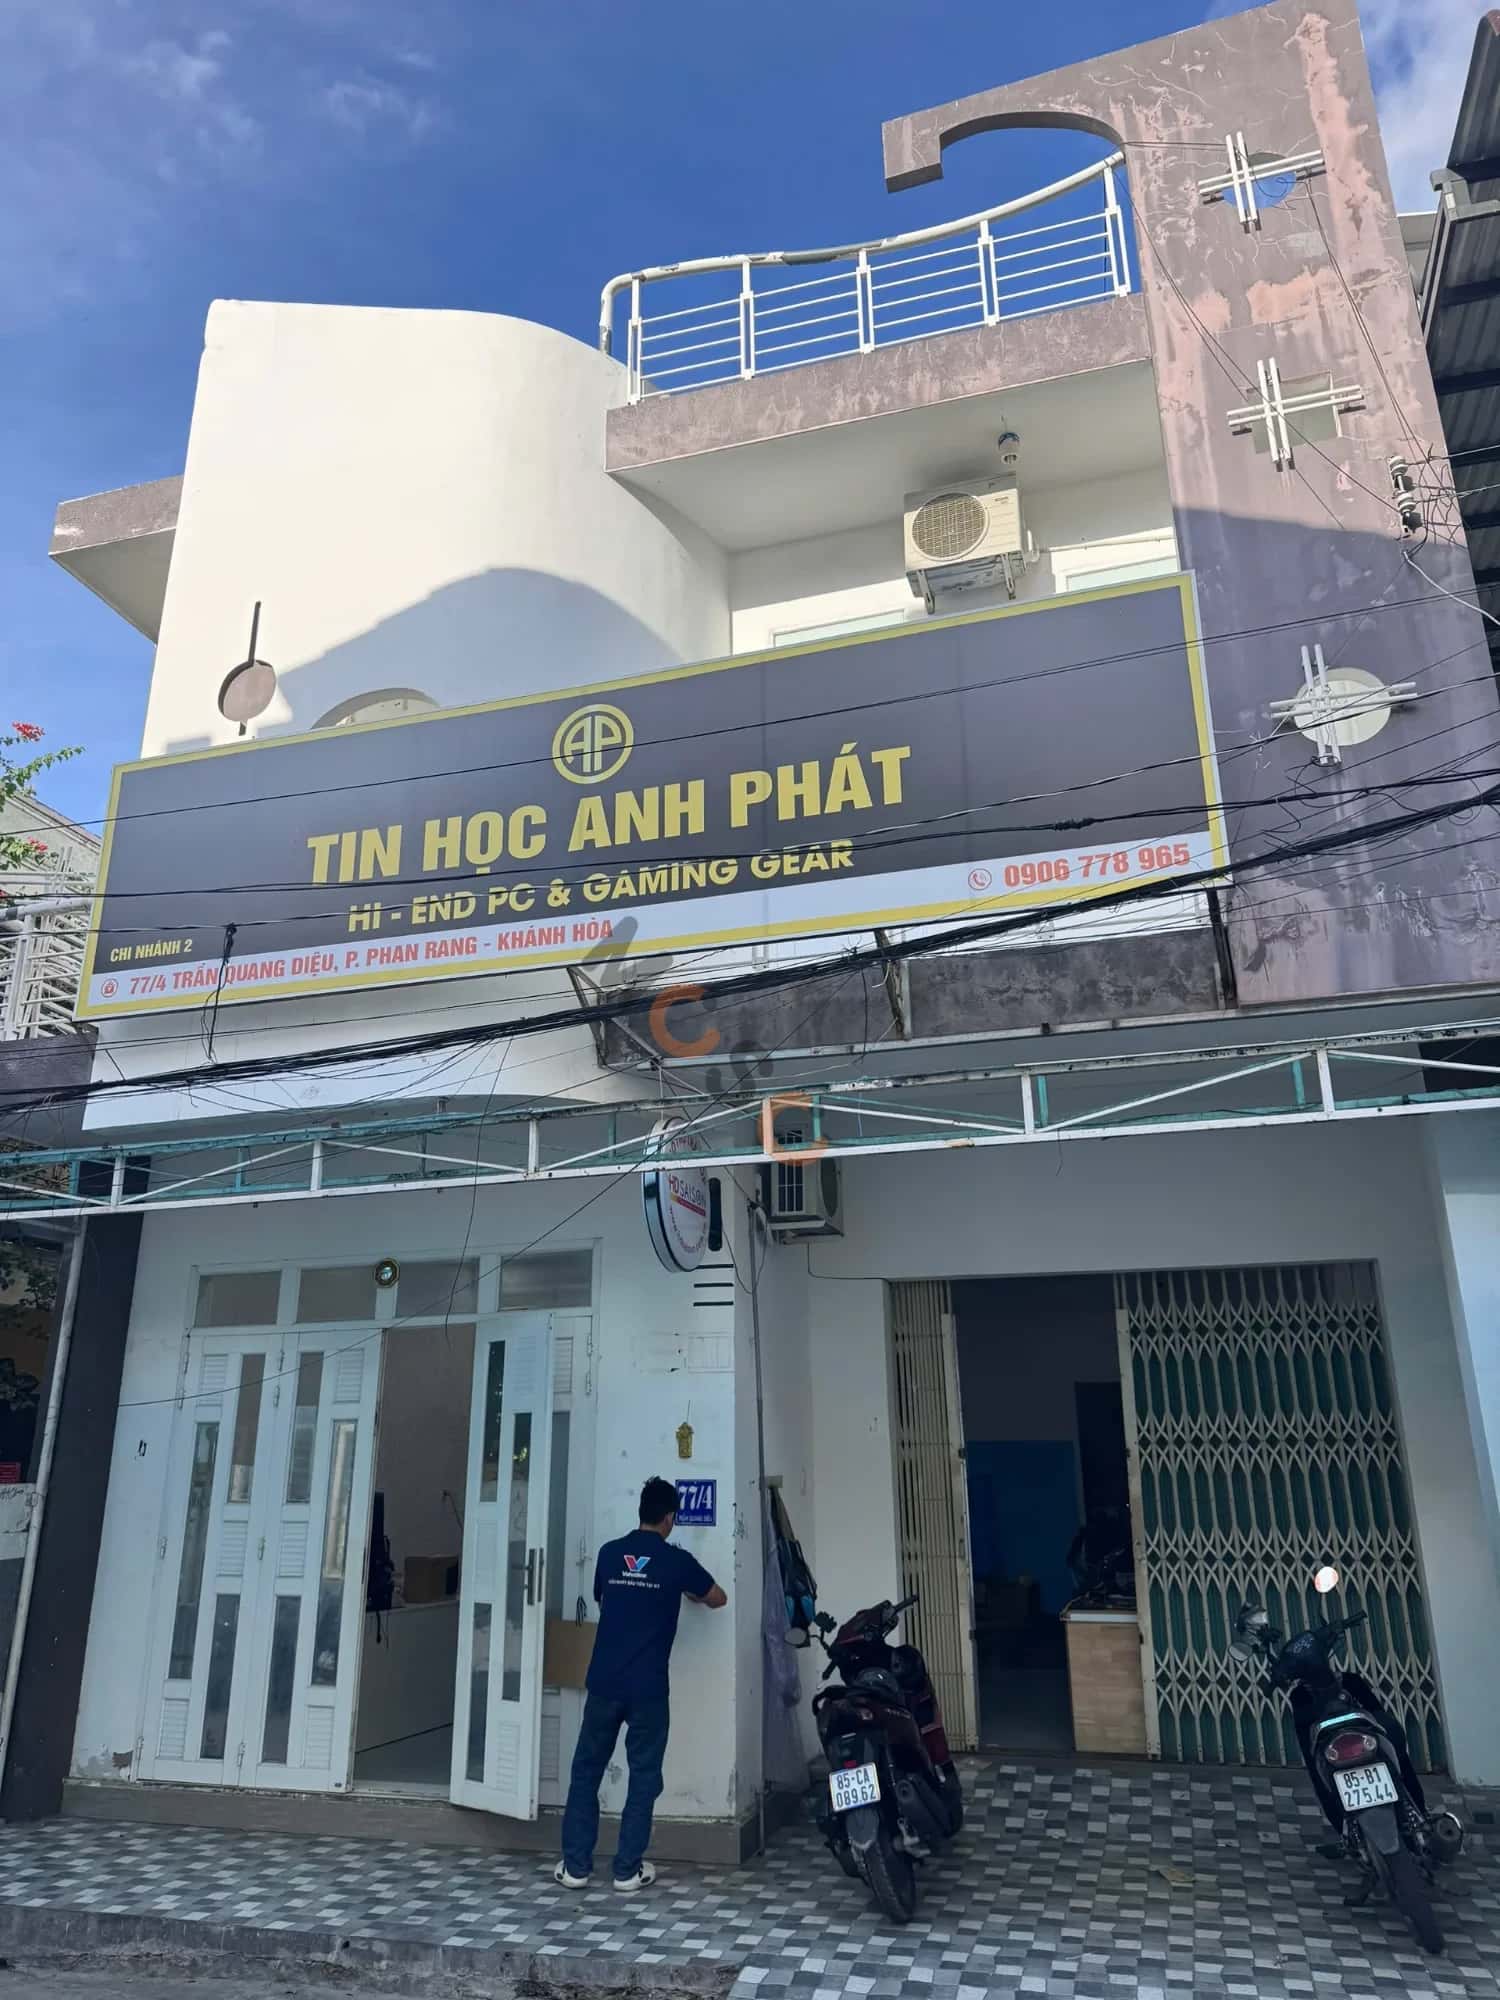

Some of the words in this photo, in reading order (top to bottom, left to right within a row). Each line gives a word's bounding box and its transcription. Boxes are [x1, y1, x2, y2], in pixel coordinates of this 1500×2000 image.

[307, 825, 402, 887] TIN
[423, 805, 547, 875] HỌC
[568, 779, 705, 852] ANH
[730, 741, 911, 828] PHÁT
[1004, 858, 1070, 887] 0906
[1078, 852, 1129, 878] 778
[1138, 843, 1190, 870] 965
[348, 902, 381, 932] HI
[411, 891, 476, 924] END
[488, 883, 535, 915] PC
[547, 878, 571, 908] &
[583, 859, 738, 902] GAMING
[751, 840, 854, 879] GEAR
[110, 946, 132, 962] CHI
[135, 940, 181, 960] NHÁNH
[184, 939, 193, 953] 2
[128, 976, 166, 995] 77/4
[225, 959, 285, 985] QUANG
[291, 952, 338, 977] DIỆU,
[346, 951, 360, 968] P.
[366, 943, 418, 967] PHAN
[425, 936, 477, 960] RANG
[497, 925, 566, 951] KHÁNH
[678, 1485, 712, 1510] 77/4
[836, 1767, 870, 1790] 85-CA
[1343, 1767, 1381, 1788] 85-B1
[1344, 1783, 1393, 1807] 275.44
